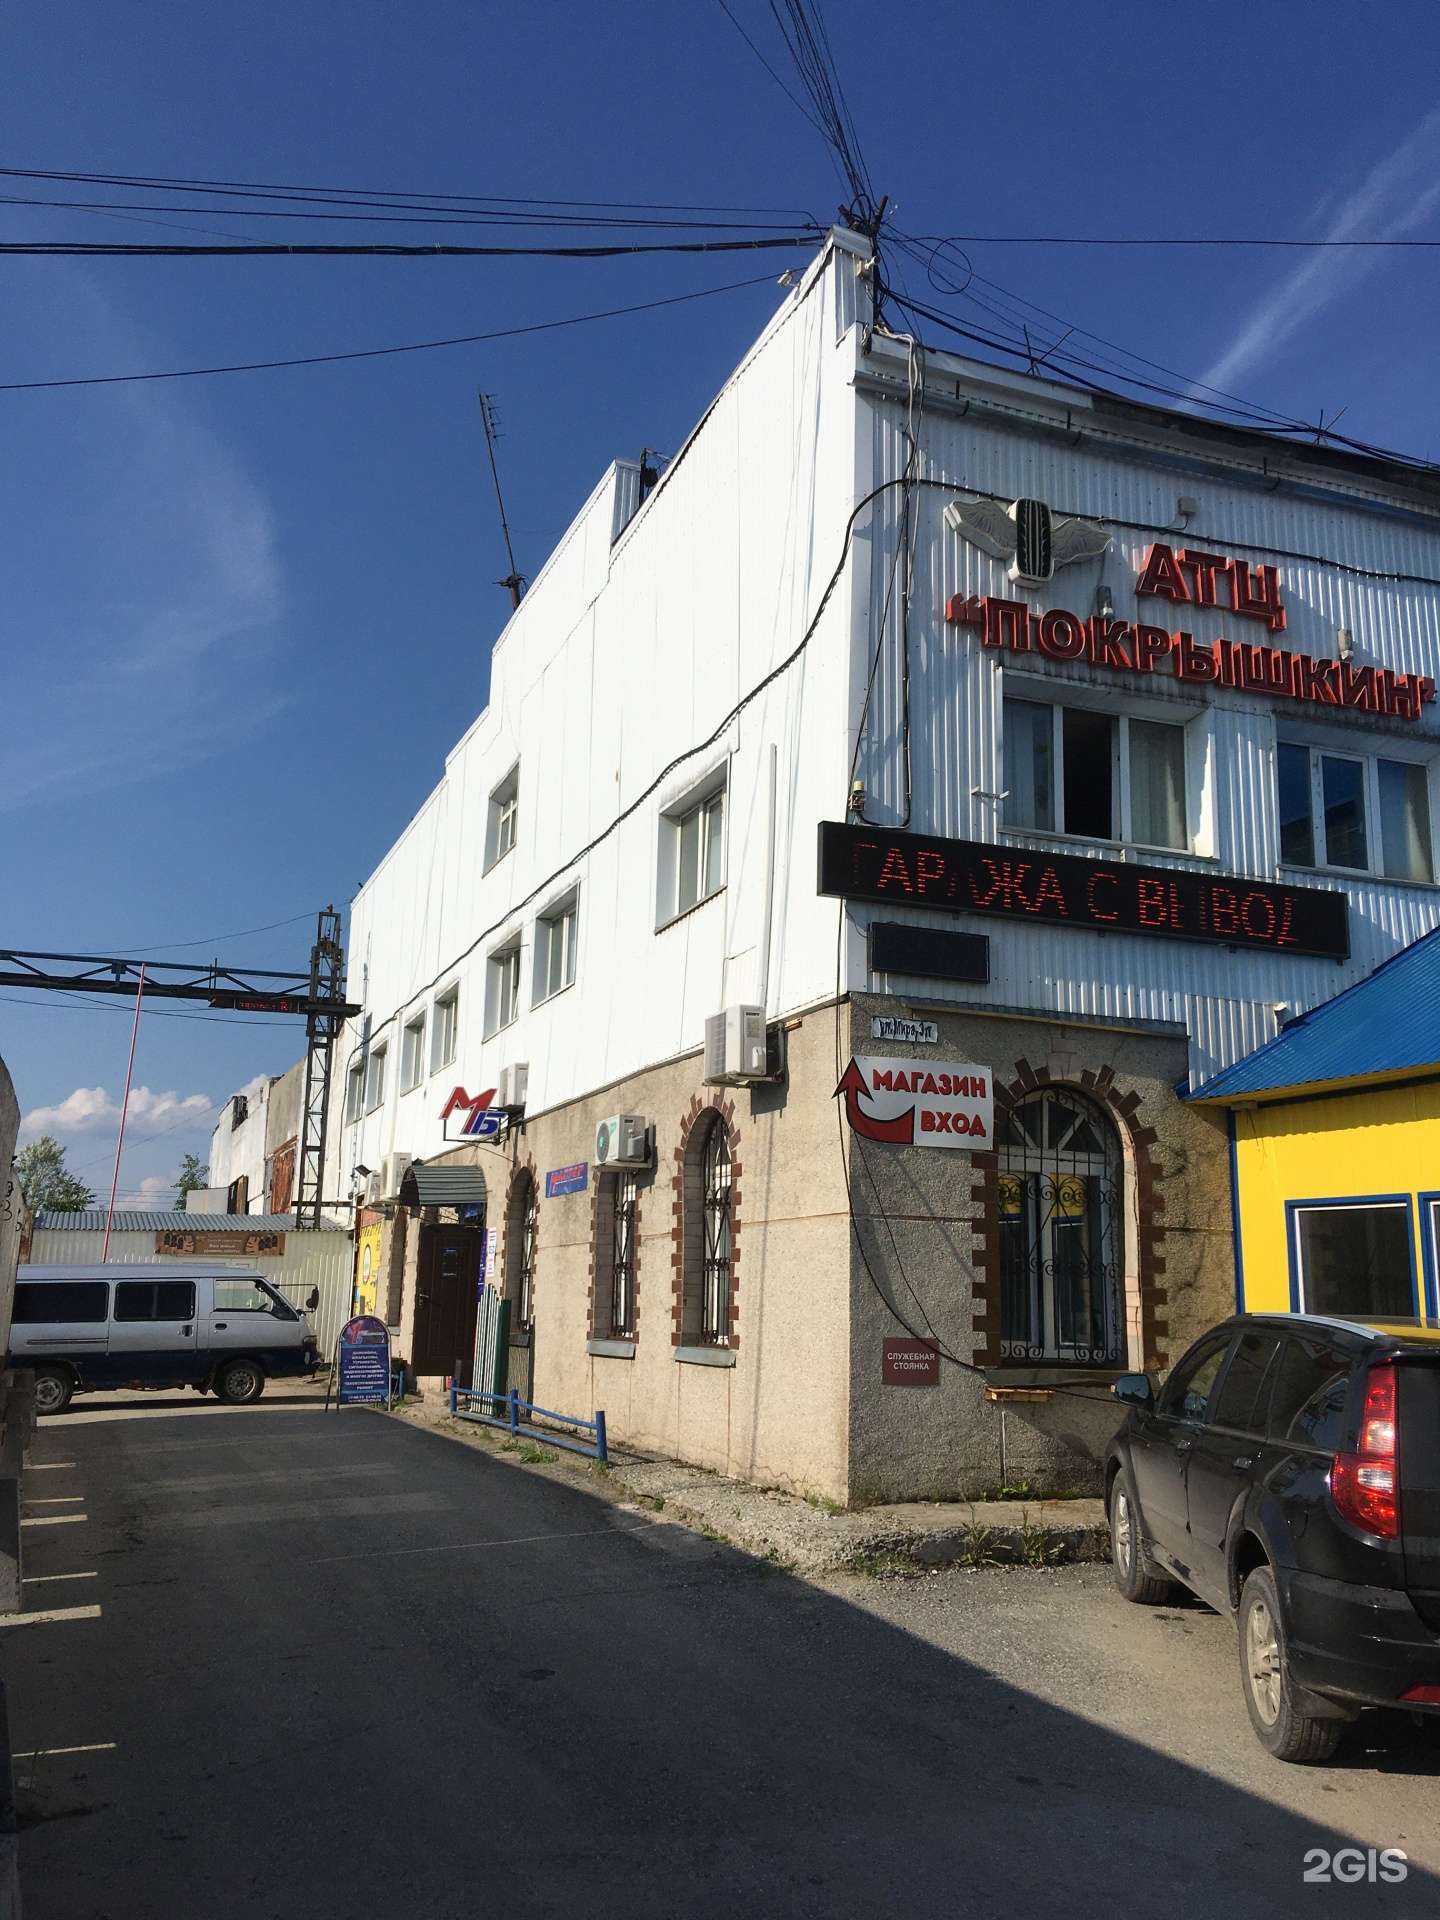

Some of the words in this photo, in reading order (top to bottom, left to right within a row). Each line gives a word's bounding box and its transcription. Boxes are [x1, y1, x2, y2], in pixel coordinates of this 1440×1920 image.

[1135, 542, 1287, 632] АТЦ
[1087, 872, 1120, 921] С
[872, 1068, 987, 1099] МАГАЗИН
[920, 1110, 987, 1138] ВХОД
[887, 1352, 936, 1361] СЛУЖЕБНАЯ
[893, 1362, 930, 1370] СТОЯНКА
